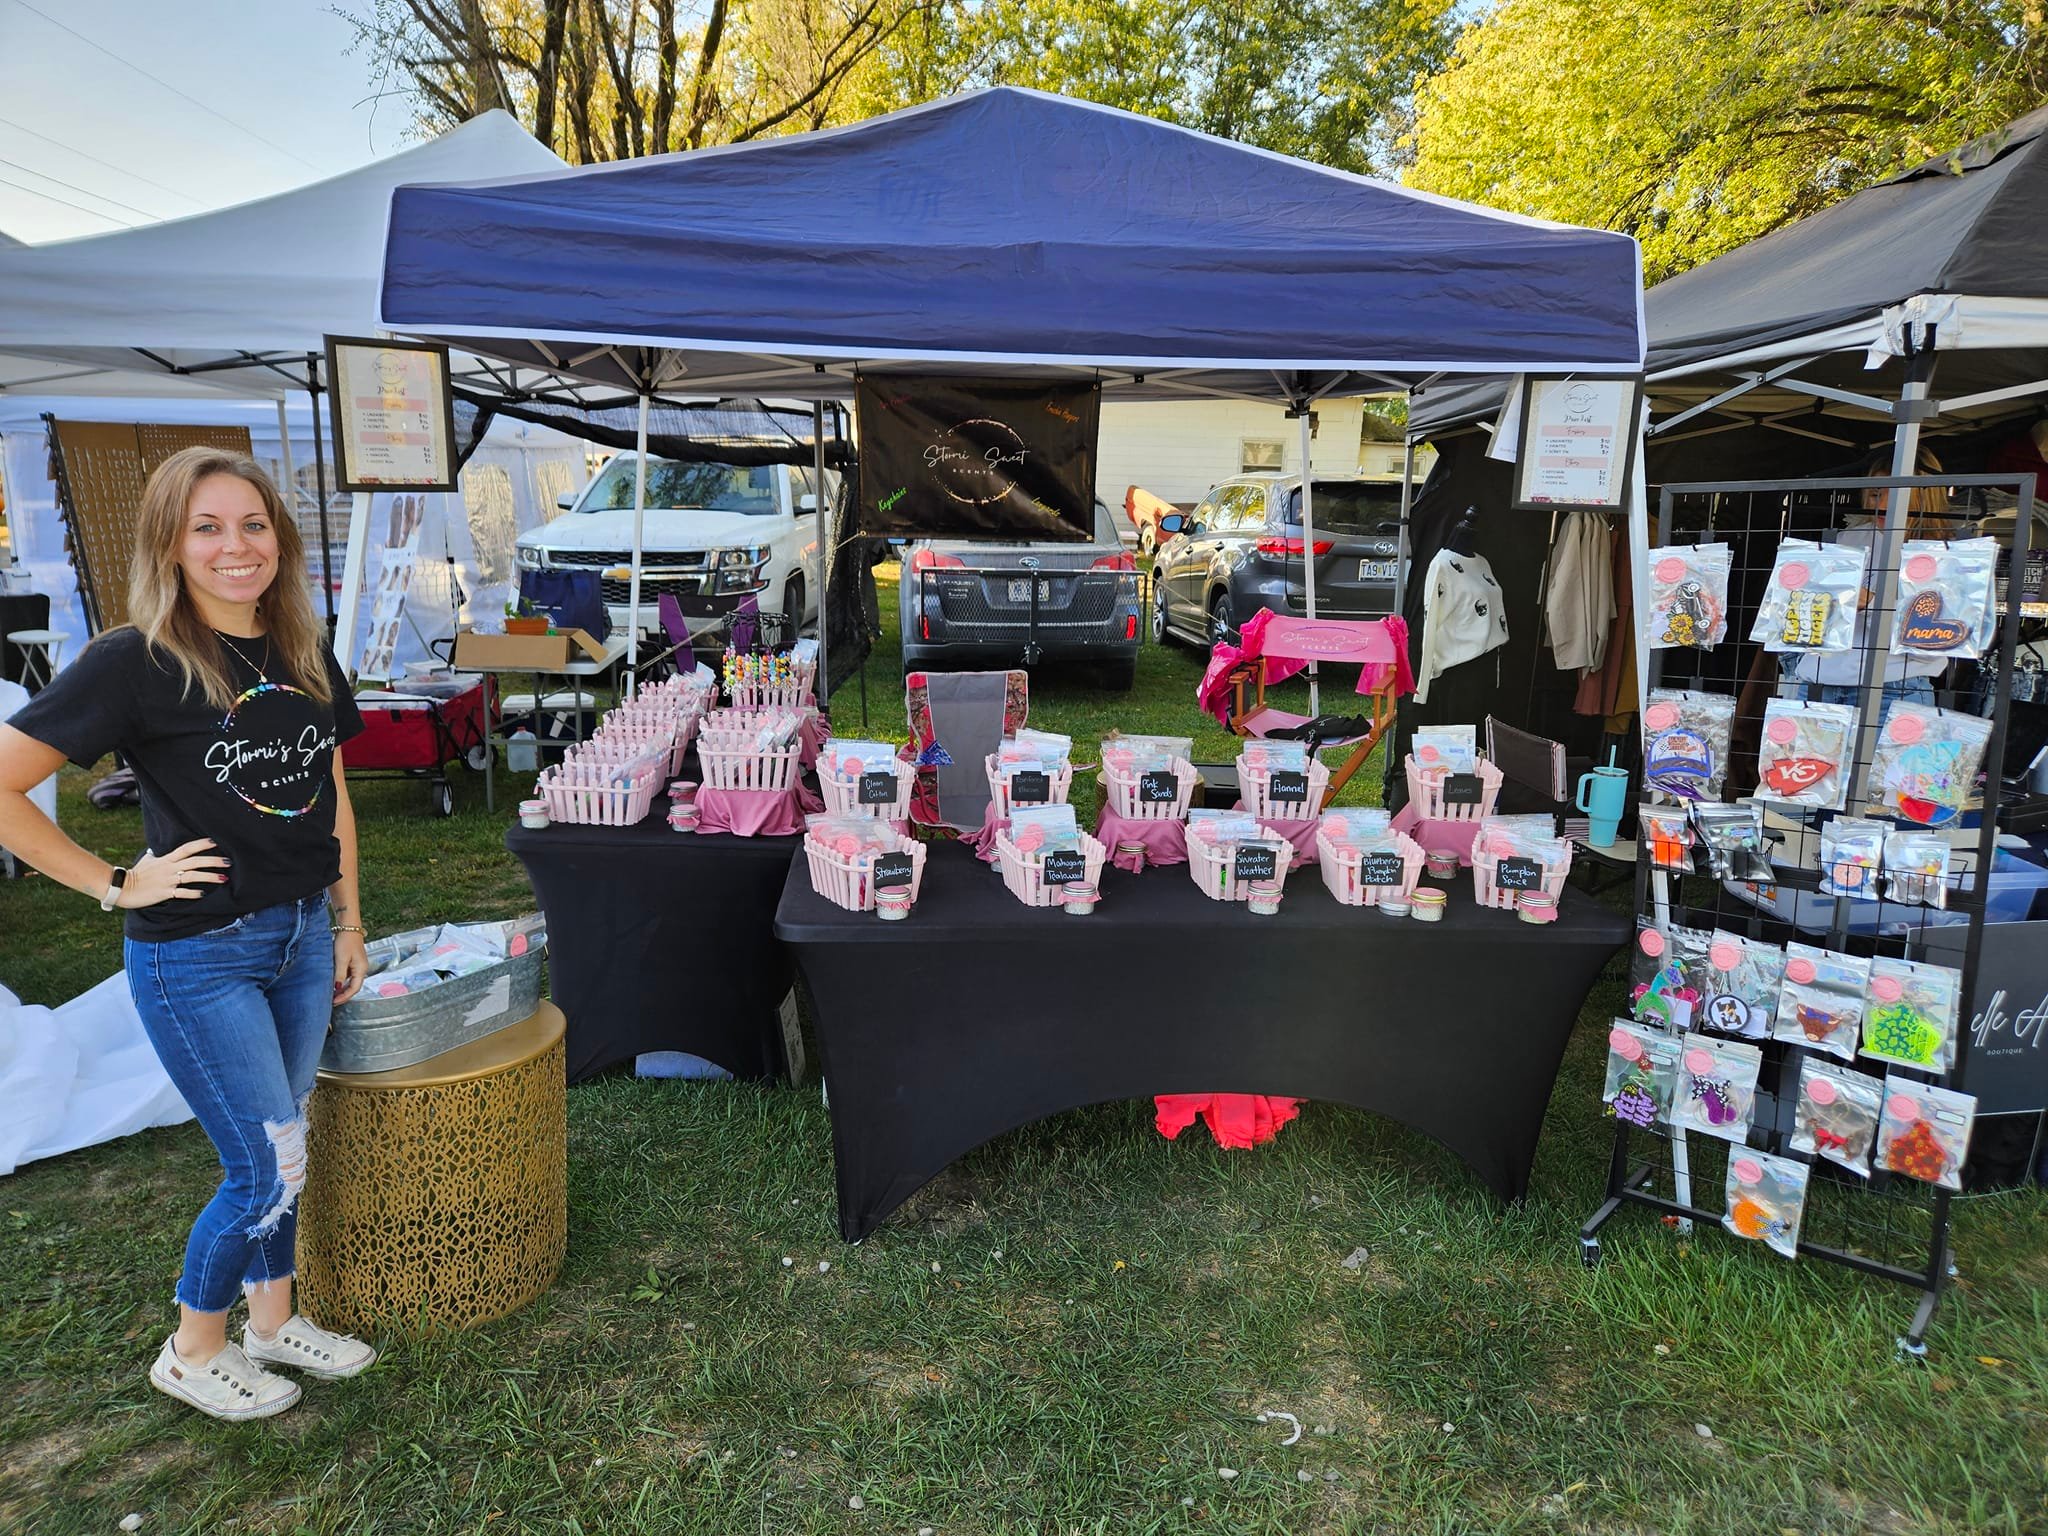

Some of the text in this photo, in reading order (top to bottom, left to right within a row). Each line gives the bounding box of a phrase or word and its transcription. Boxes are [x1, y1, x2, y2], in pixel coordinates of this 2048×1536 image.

[984, 447, 1030, 468] Sweet
[952, 467, 995, 476] SCENTS
[1361, 564, 1377, 577] TA9
[2024, 567, 2043, 576] ITCH
[1782, 590, 1804, 644] TIGERS
[1809, 592, 1832, 647] TIGERS
[1906, 627, 1954, 640] mama
[204, 737, 292, 783] Stormi's
[1780, 762, 1818, 783] KC
[260, 770, 310, 789] SCENTS
[865, 779, 884, 790] Clean
[1142, 779, 1158, 790] Pink
[868, 789, 889, 799] Cotton
[1151, 788, 1173, 799] Sands
[1047, 858, 1085, 870] Mahogany
[1236, 853, 1270, 864] Sweater
[1362, 857, 1402, 869] Blueberry
[875, 864, 912, 880] Strawberry
[1046, 870, 1084, 881] Teakwood
[1237, 864, 1273, 876] Weather
[1501, 863, 1537, 878] Pumpkin
[1365, 875, 1393, 884] Patch
[1502, 876, 1528, 886] Spice
[1986, 1047, 2023, 1056] BOUTIQUE
